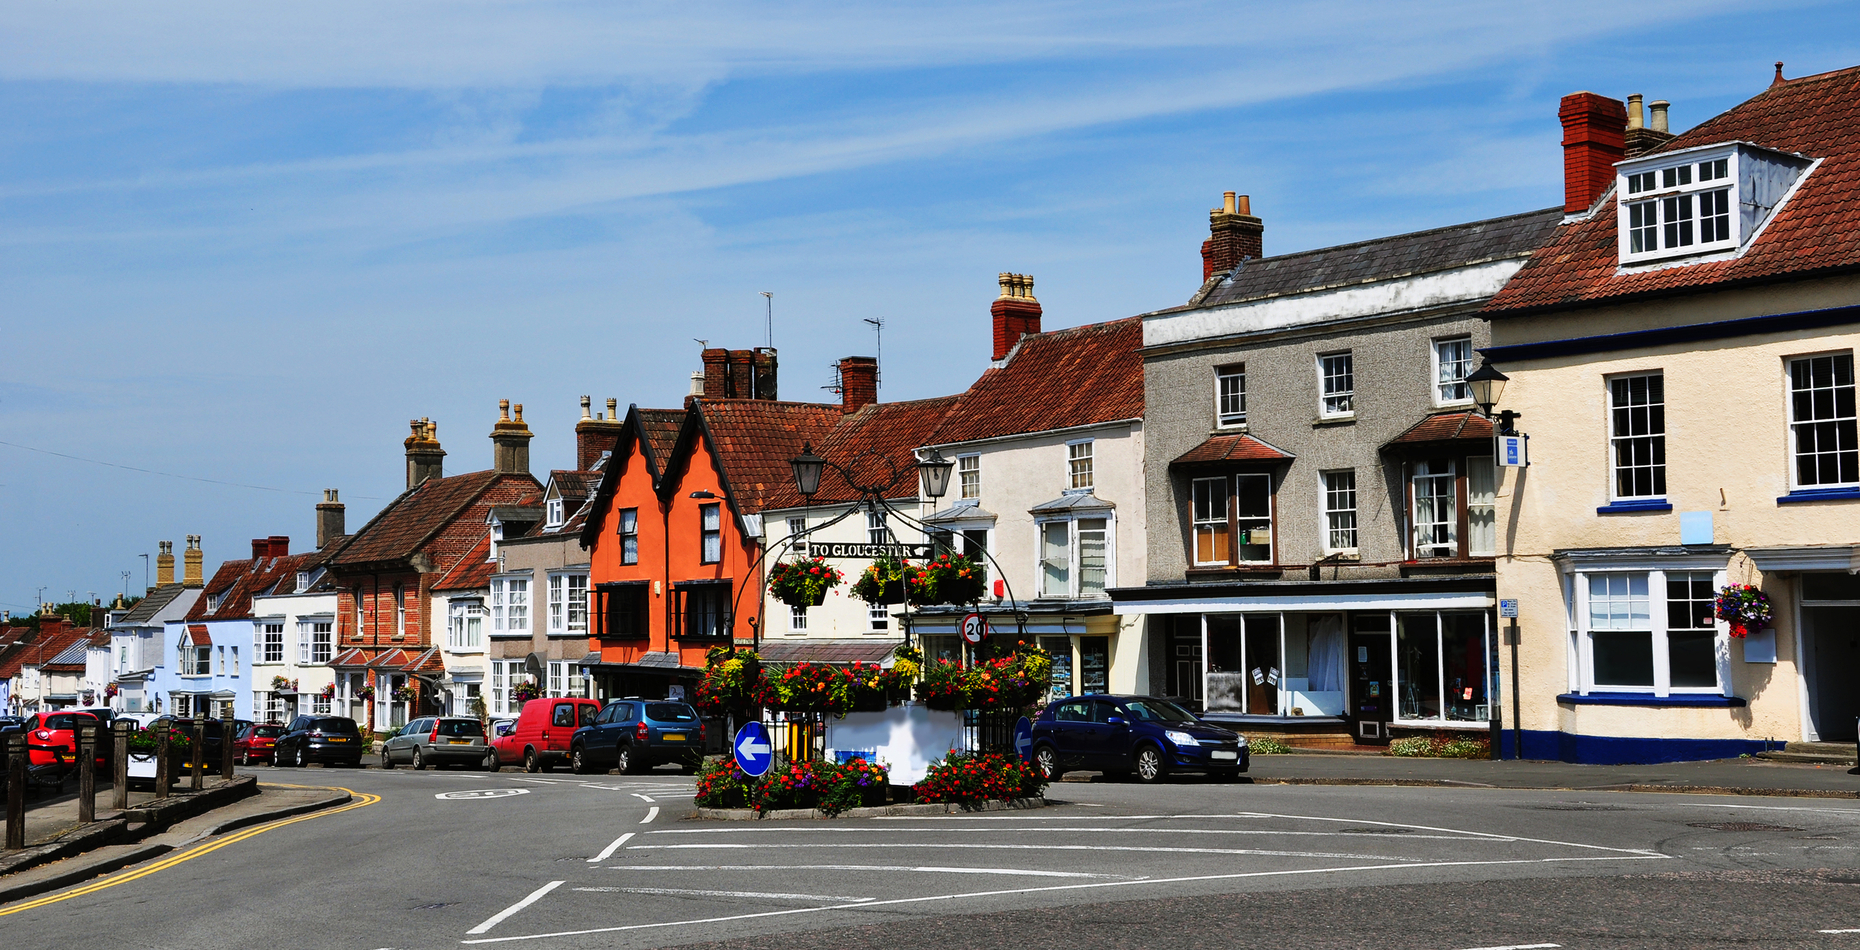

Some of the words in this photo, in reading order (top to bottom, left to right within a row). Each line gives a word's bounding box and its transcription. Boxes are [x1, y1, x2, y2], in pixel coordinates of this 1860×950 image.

[811, 544, 829, 556] TO
[832, 544, 912, 557] GLOUCESTER
[966, 622, 984, 636] 20
